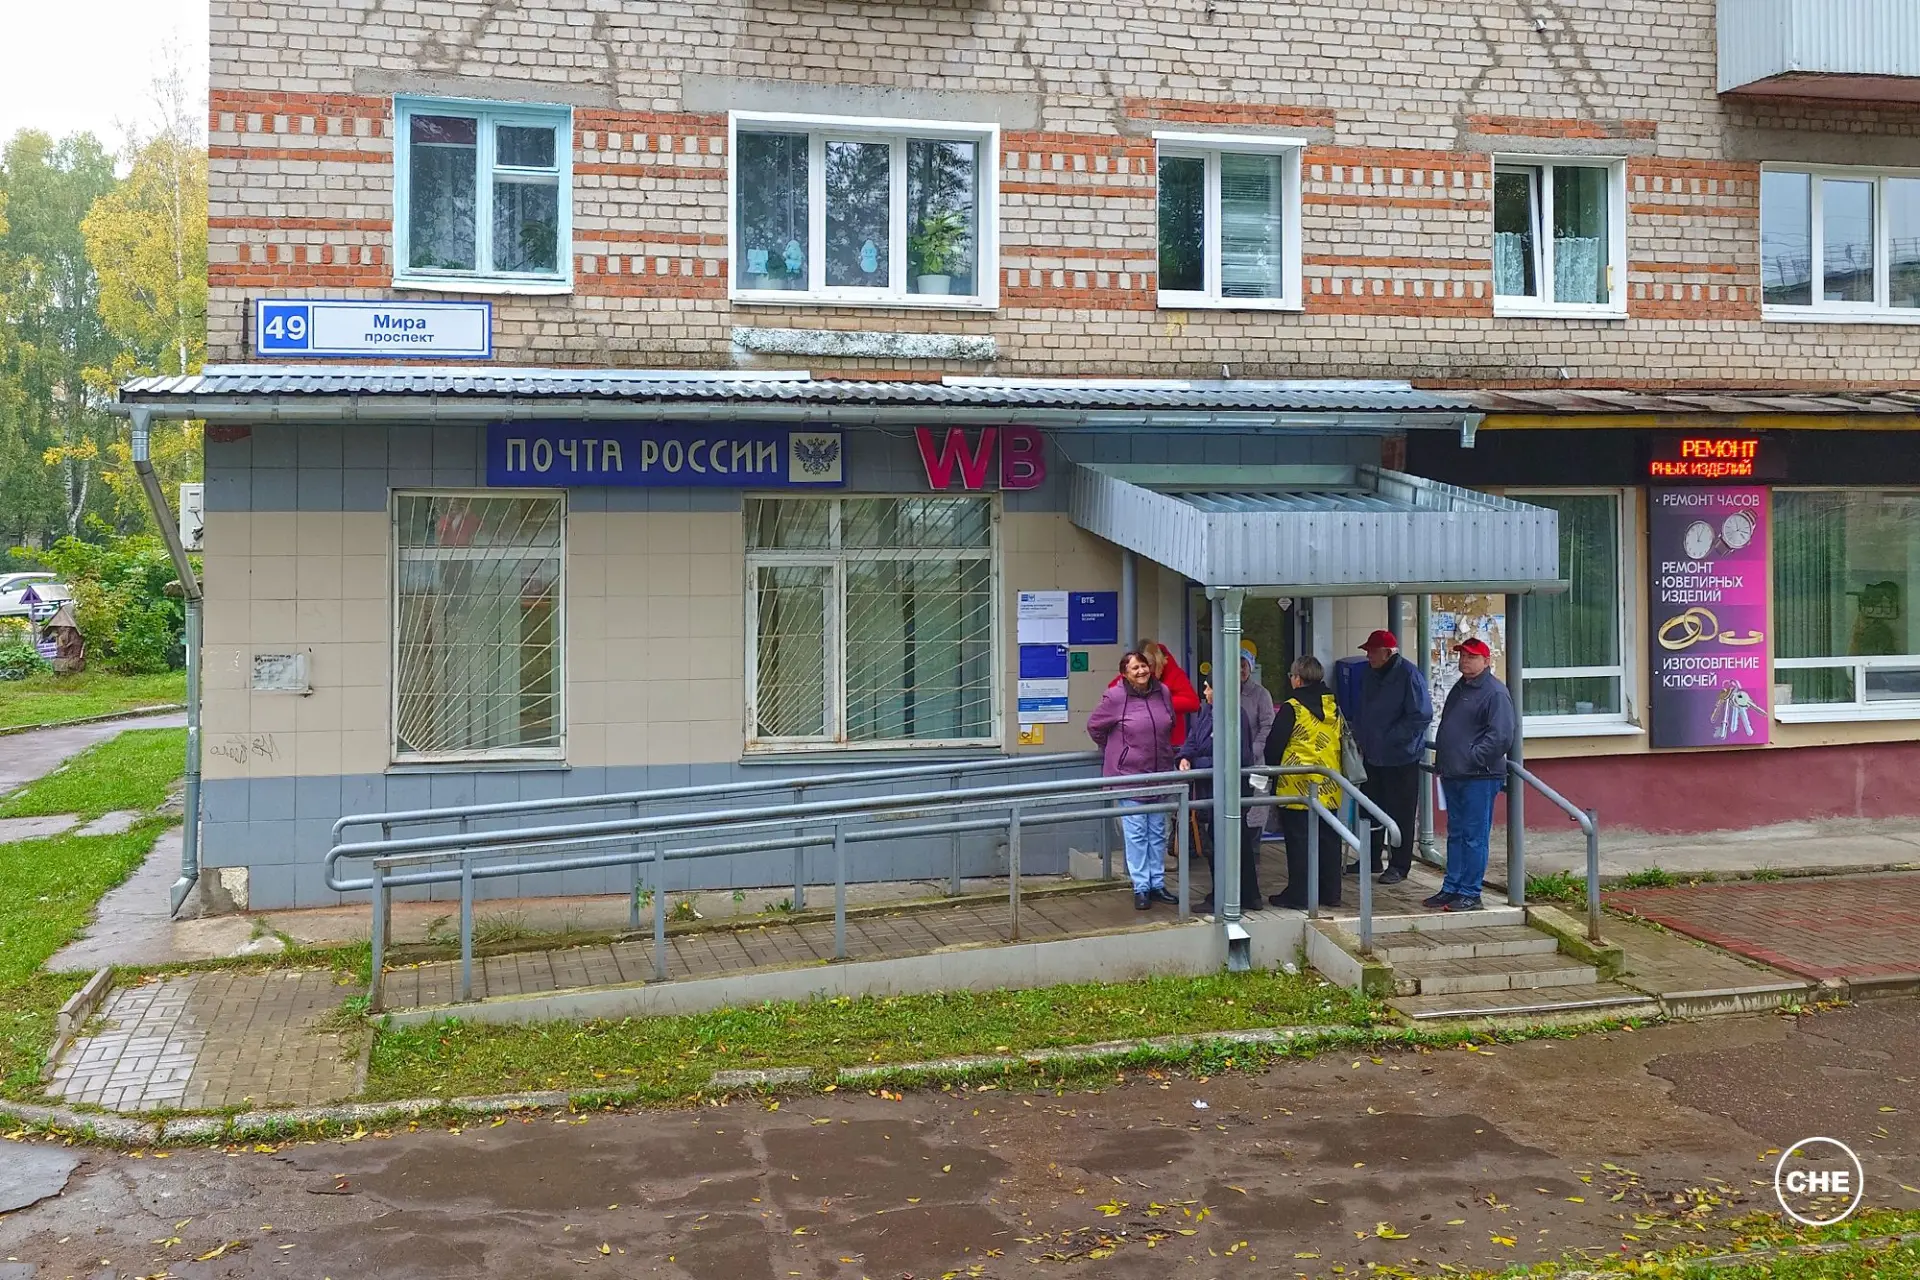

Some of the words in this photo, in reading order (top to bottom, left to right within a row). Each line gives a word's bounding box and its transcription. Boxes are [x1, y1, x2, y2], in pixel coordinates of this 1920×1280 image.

[265, 315, 306, 340] 49
[373, 314, 427, 332] Мира
[364, 332, 435, 344] проспект
[506, 437, 622, 473] ПОЧТА
[641, 438, 778, 475] РОССИИ
[1682, 439, 1758, 458] РЕМОНТ
[913, 425, 1047, 492] WB
[1651, 461, 1689, 476] РНЫХ
[1691, 459, 1752, 478] ИЗДЕЛИЙ
[1662, 494, 1714, 507] РЕМОНТ
[1717, 494, 1760, 507] ЧАСОВ
[1662, 561, 1714, 574] РЕМОНТ
[1661, 575, 1744, 589] ЮВЕЛИРНЫХ
[1081, 596, 1095, 604] ВТБ
[1661, 588, 1722, 604] ИЗДЕЛИЙ
[1662, 656, 1760, 671] ИЗГОТОВЛЕНИЕ
[1662, 672, 1718, 688] КЛЮЧЕЙ
